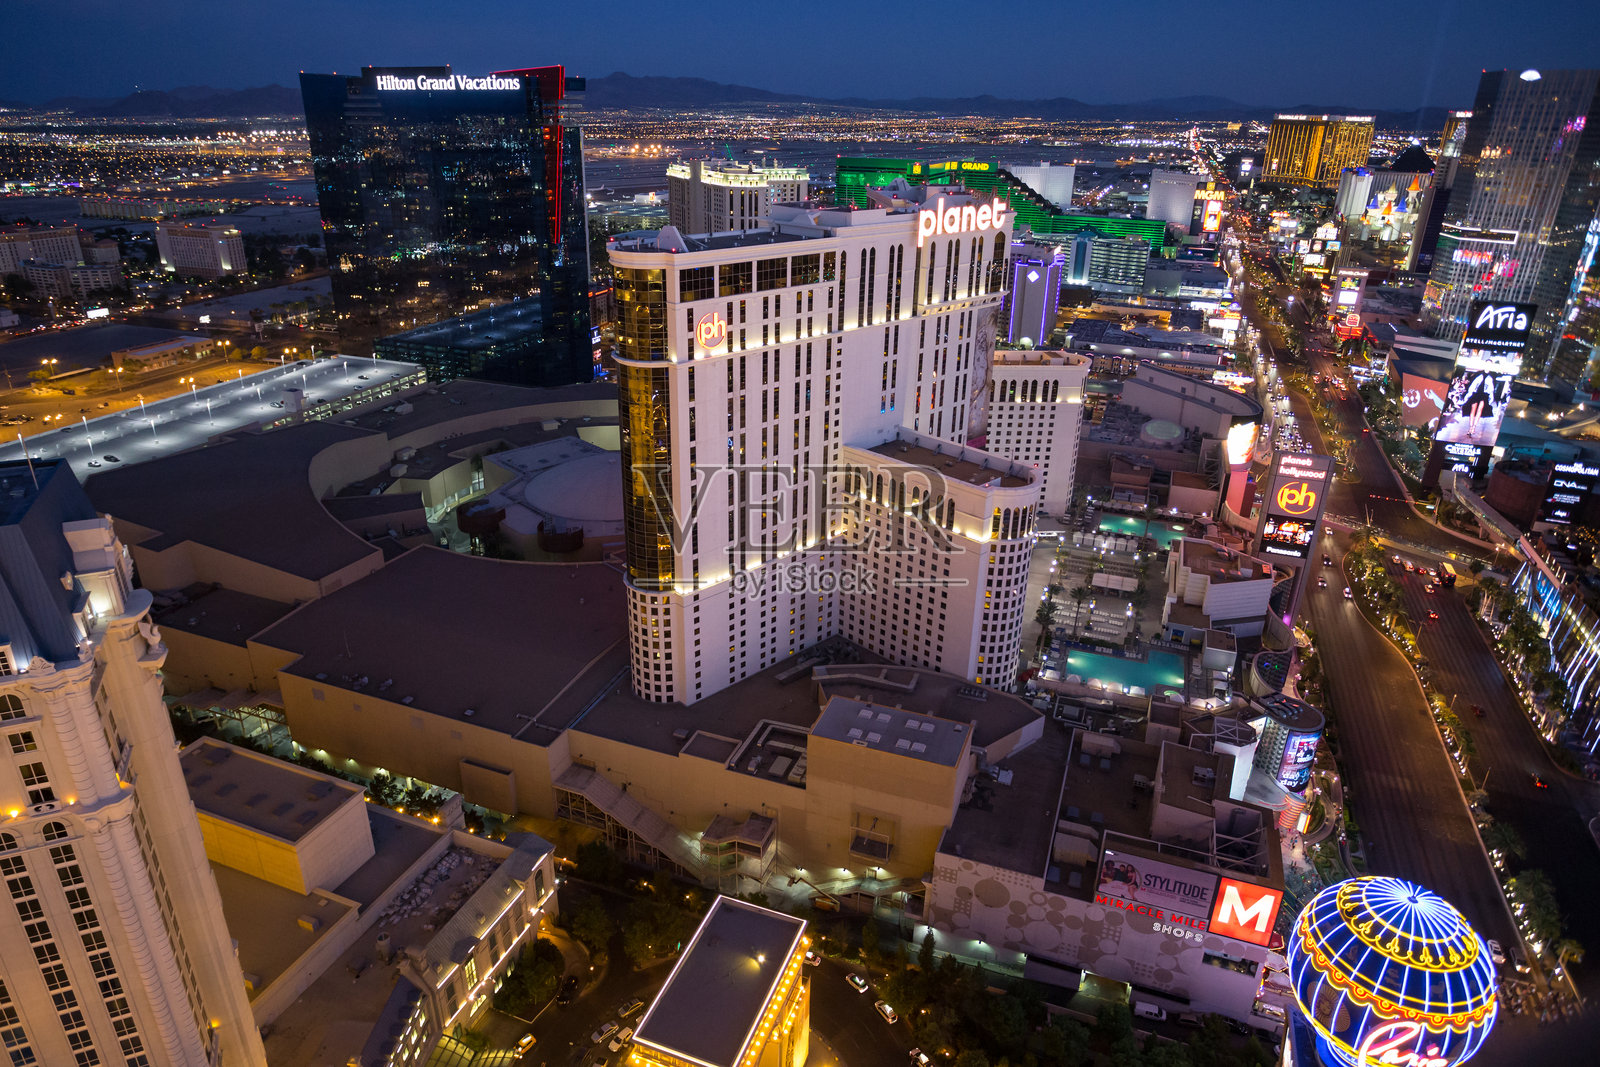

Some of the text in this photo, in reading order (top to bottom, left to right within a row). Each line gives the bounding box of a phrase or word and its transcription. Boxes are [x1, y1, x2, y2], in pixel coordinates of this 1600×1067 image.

[376, 75, 520, 91] Hilton Grand Vacations
[961, 162, 989, 171] GRAND
[1194, 190, 1225, 200] MGM
[917, 197, 1007, 248] planet
[1475, 304, 1527, 331] Aria
[698, 312, 727, 347] ph
[1281, 455, 1313, 467] planet
[1555, 464, 1599, 476] COSMOPOLITAN
[1279, 466, 1326, 479] hollywood
[1279, 483, 1316, 510] ph
[1266, 546, 1302, 557] Panasonic
[1280, 779, 1298, 788] day
[1143, 873, 1210, 901] STYLITUDE
[1095, 894, 1164, 920] MIRACLE
[1171, 913, 1207, 931] MILE
[1218, 885, 1275, 933] M
[1152, 922, 1204, 942] SHOPS
